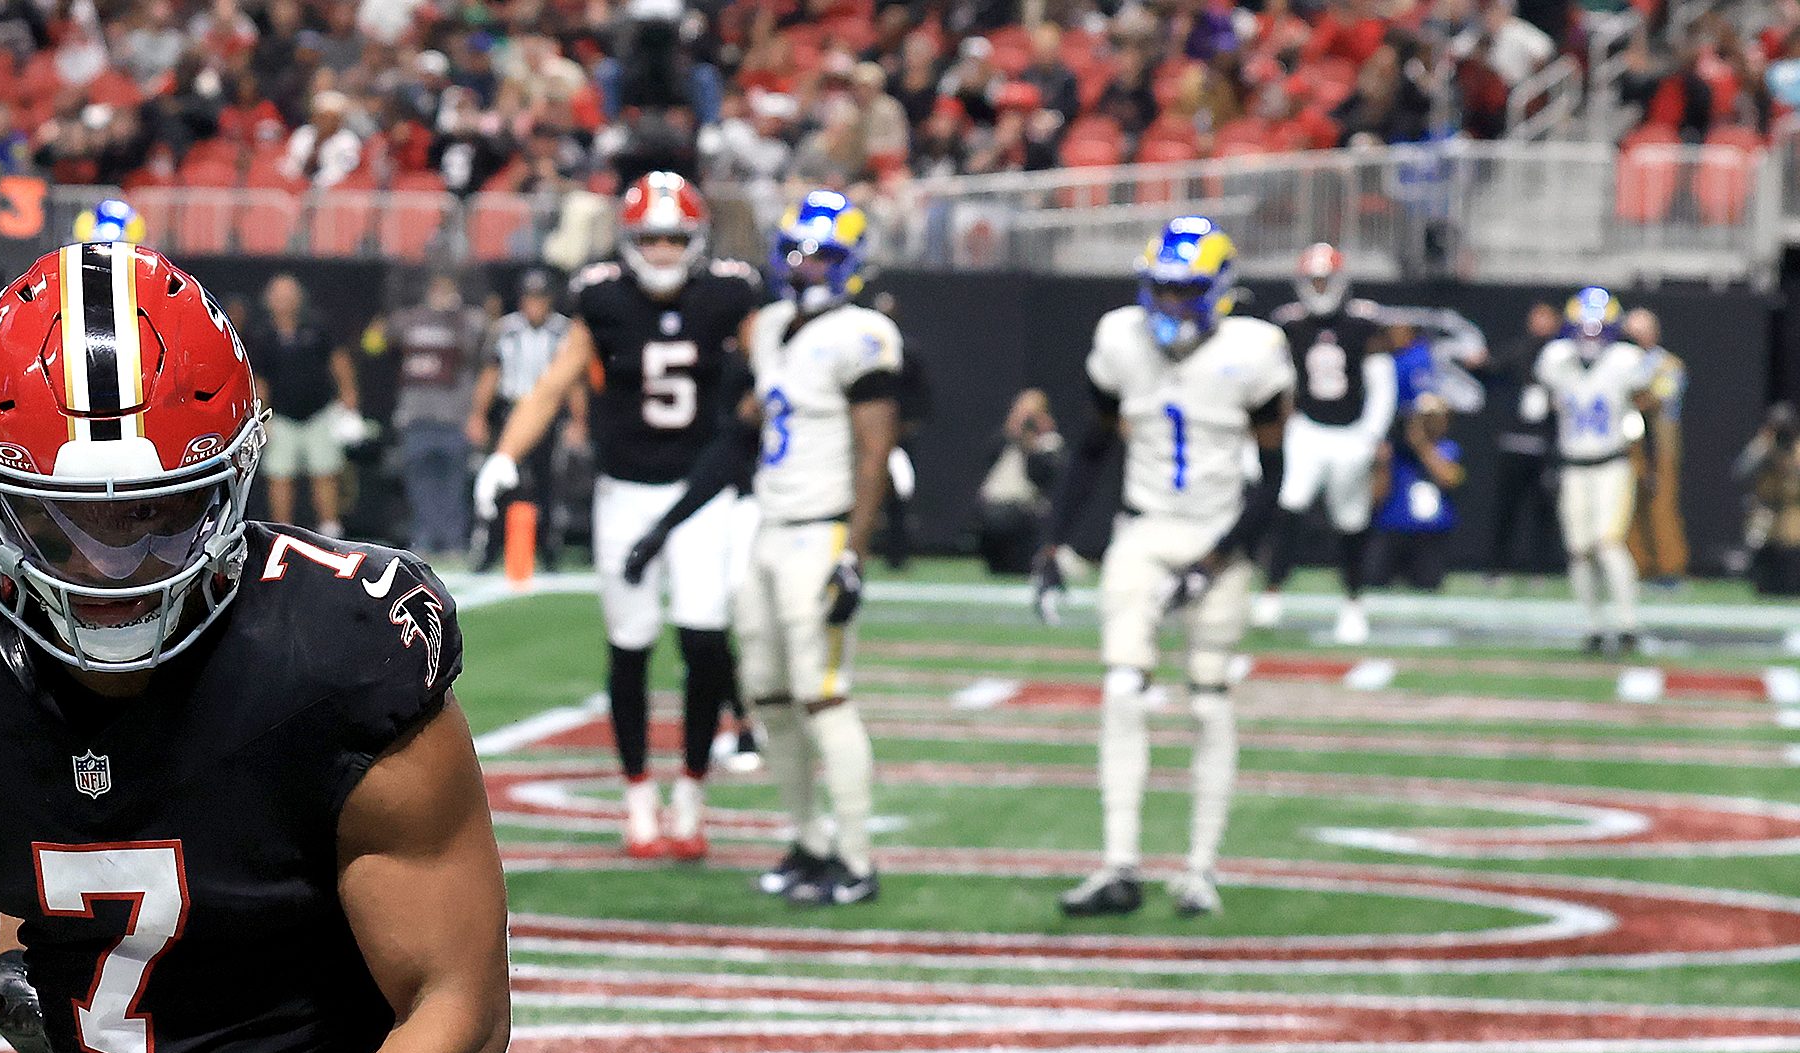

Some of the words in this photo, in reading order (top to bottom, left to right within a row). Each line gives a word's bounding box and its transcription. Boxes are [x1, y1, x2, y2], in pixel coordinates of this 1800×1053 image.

[642, 340, 698, 429] 5
[185, 444, 222, 463] OAKLEY
[1164, 404, 1187, 489] 1
[260, 533, 367, 581] 7
[79, 772, 106, 789] NFL
